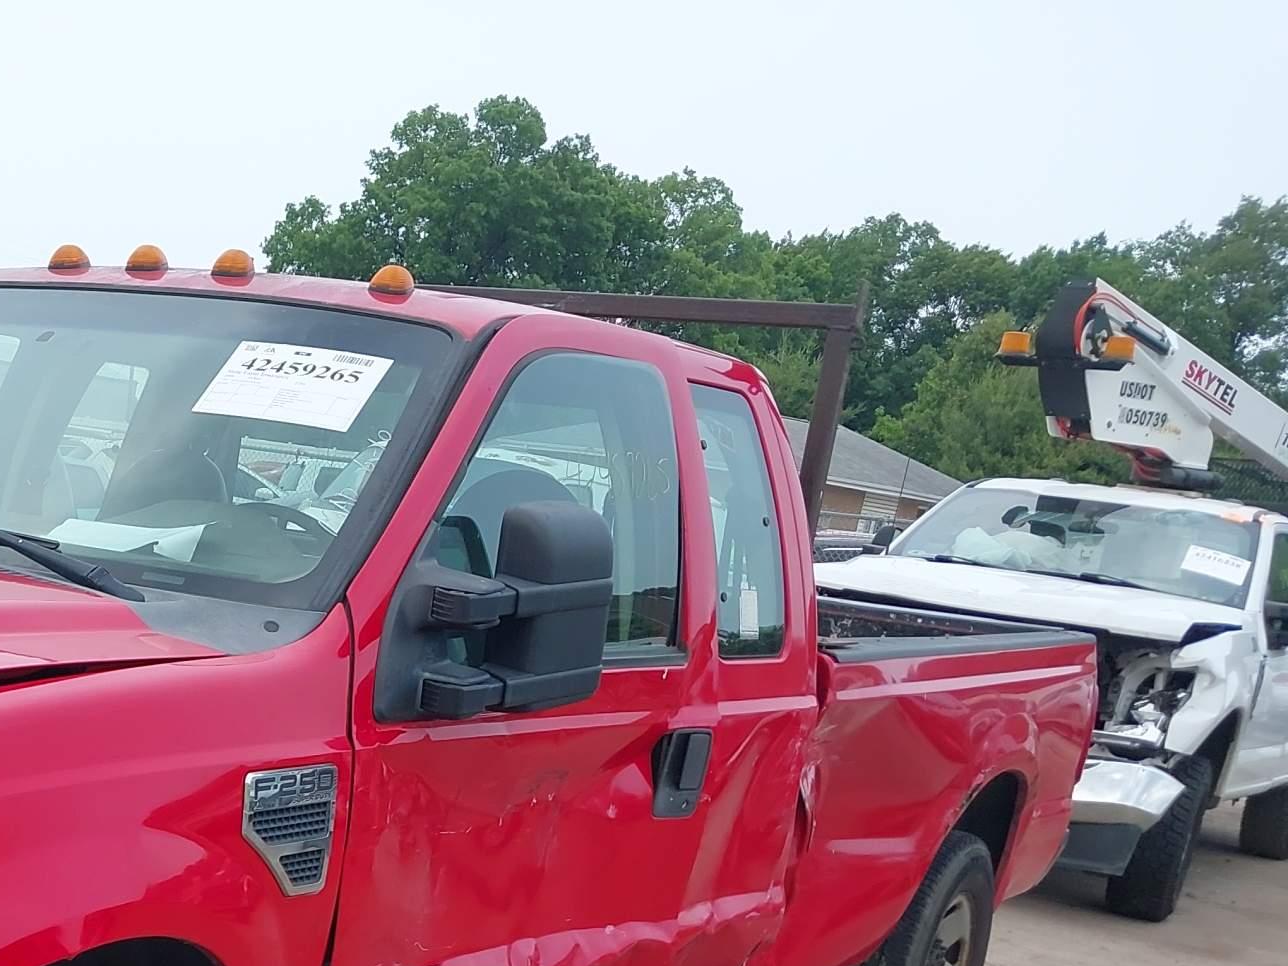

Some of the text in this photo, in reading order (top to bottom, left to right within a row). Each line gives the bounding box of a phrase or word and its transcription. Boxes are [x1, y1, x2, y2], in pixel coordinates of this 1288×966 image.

[241, 357, 364, 384] 42459265
[1184, 359, 1238, 409] SKYTEL
[1120, 380, 1156, 401] USDOT
